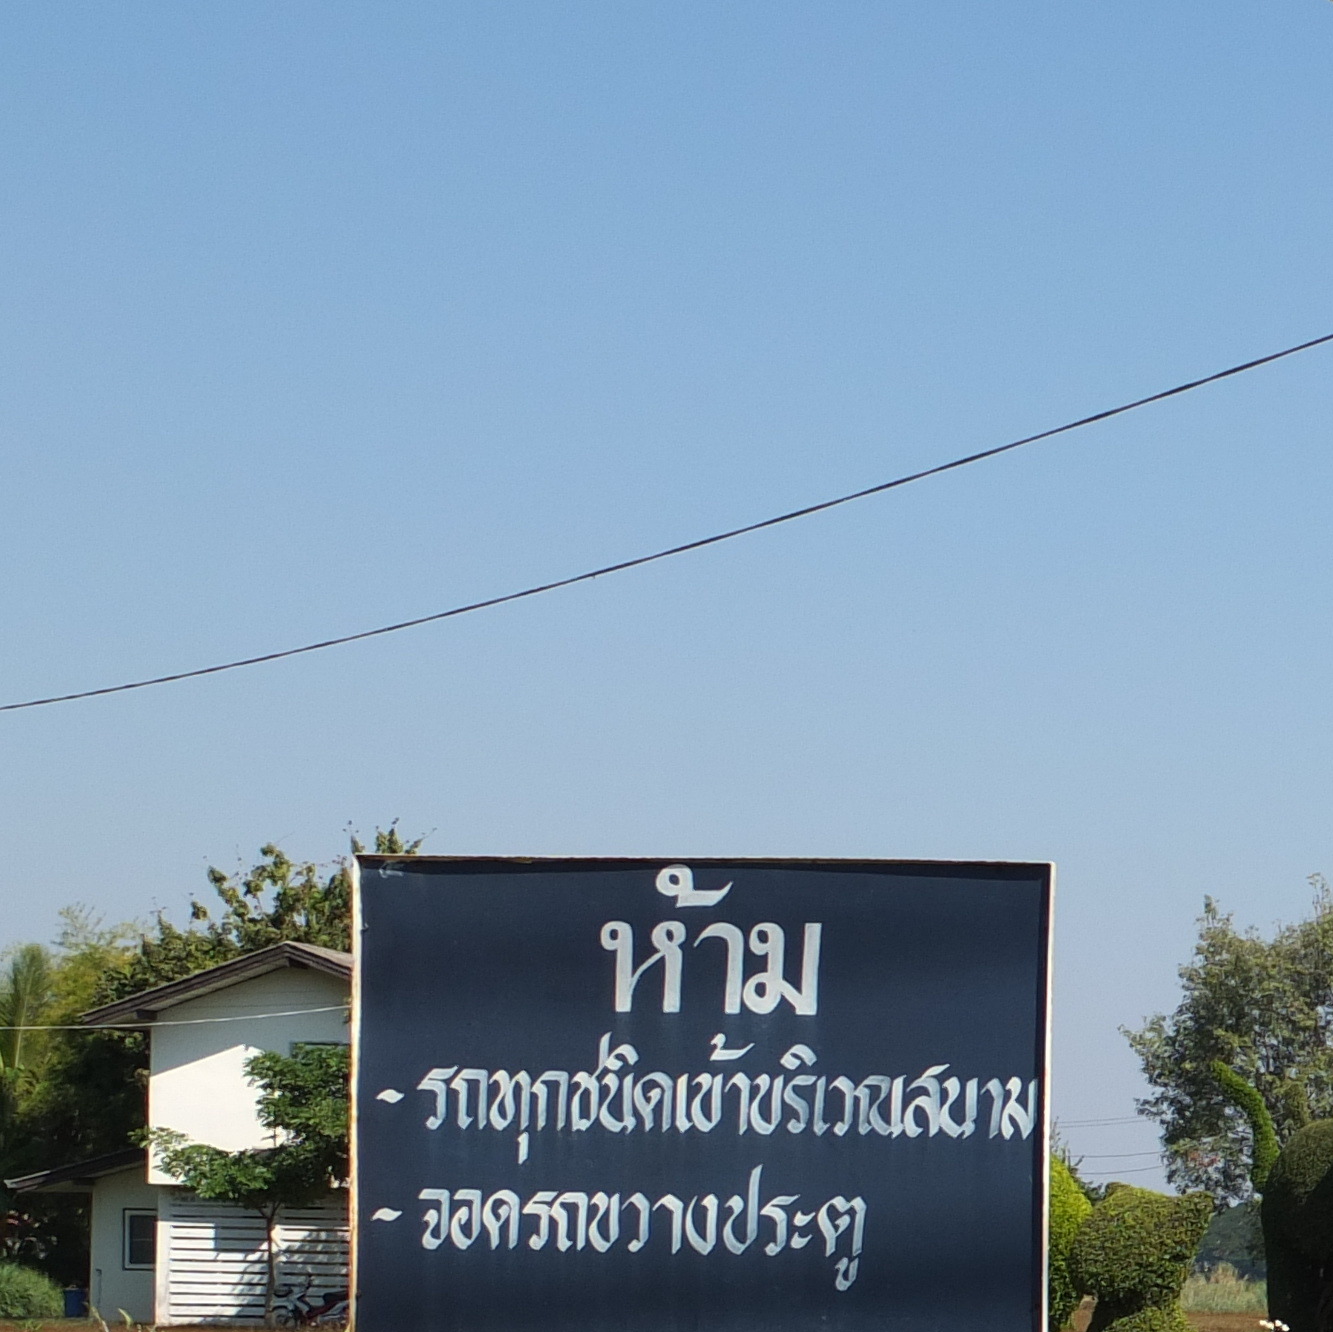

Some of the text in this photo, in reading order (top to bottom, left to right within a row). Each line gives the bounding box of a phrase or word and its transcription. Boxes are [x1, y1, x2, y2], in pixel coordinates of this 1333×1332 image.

[599, 865, 823, 1016] ห้าม
[418, 1163, 868, 1292] จอดรถขวางประตู
